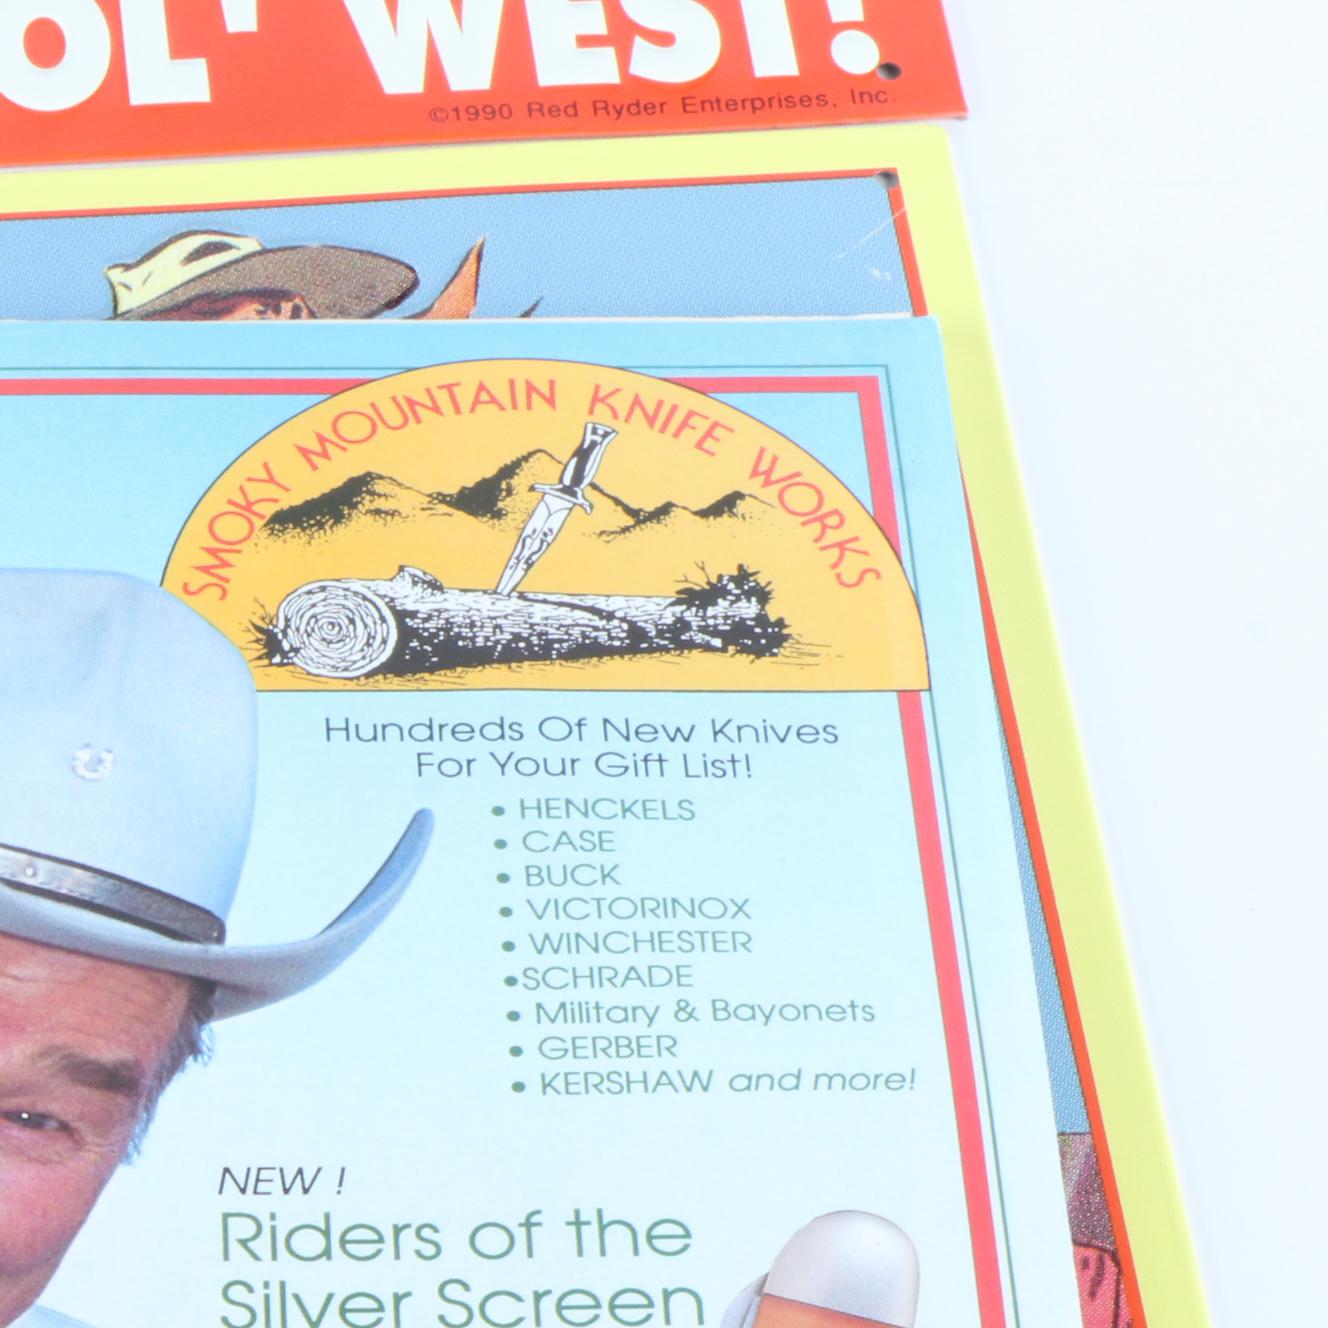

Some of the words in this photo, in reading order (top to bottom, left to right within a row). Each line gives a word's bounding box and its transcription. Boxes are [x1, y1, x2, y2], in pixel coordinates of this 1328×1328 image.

[341, 0, 881, 94] WEST!
[527, 100, 579, 119] Red
[592, 97, 668, 120] Ryder
[682, 90, 838, 115] Enterprises,
[850, 87, 897, 105] Inc.
[182, 463, 292, 600] SMOKY
[294, 379, 557, 473] MOUNTAIN
[587, 383, 735, 460] KNIFE
[748, 446, 882, 590] WORKS
[324, 716, 524, 743] Hundreds
[538, 716, 587, 743] Of
[603, 717, 697, 743] New
[711, 718, 839, 744] Knives
[416, 752, 477, 777] For
[489, 752, 581, 777] Your
[594, 751, 669, 777] Gift
[682, 753, 753, 778] List!
[519, 798, 696, 821] HENCKELS
[522, 830, 616, 853] CASE
[525, 863, 621, 887] BUCK
[526, 897, 752, 921] VICTORINOX
[528, 931, 753, 954] WINCHESTER
[522, 965, 695, 990] SCHRADE
[535, 1002, 660, 1028] Military
[674, 999, 700, 1022] &
[711, 999, 876, 1026] Bayonets
[538, 1035, 678, 1060] GERBER
[541, 1069, 713, 1095] KERSHAW
[729, 1068, 802, 1092] and
[813, 1068, 916, 1091] more!
[218, 1166, 322, 1195] NEW
[221, 1211, 443, 1262] Riders
[468, 1209, 543, 1260] of
[564, 1207, 693, 1258] the
[437, 1278, 706, 1328] Screen
